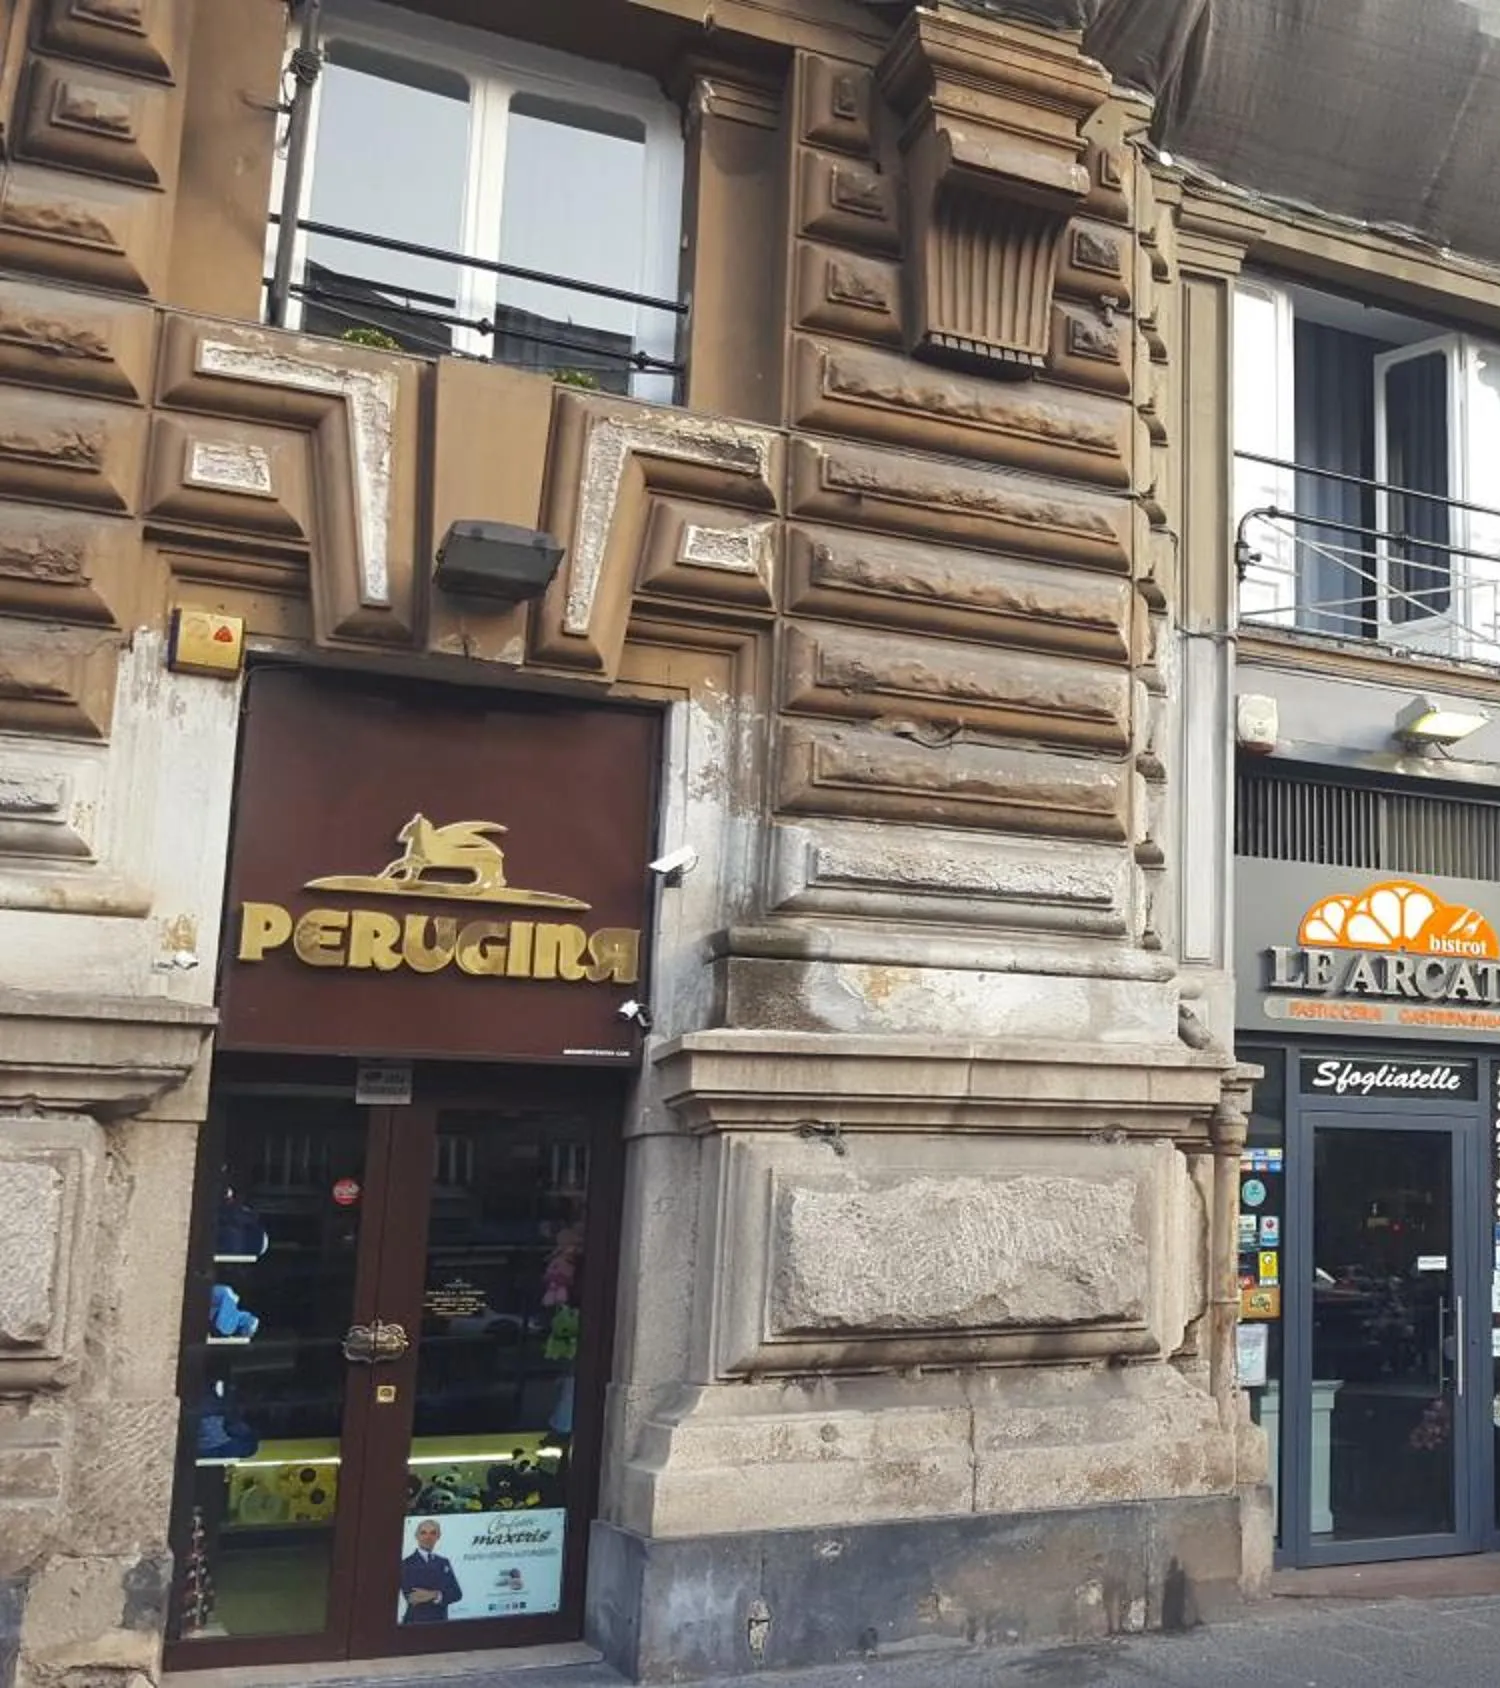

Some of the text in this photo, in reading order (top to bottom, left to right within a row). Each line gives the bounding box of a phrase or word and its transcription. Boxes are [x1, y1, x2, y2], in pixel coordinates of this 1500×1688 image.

[237, 902, 641, 984] PERUGINA
[1429, 935, 1487, 956] bistrot
[1267, 945, 1335, 990] LE
[1312, 1061, 1461, 1095] Sfogliatelle
